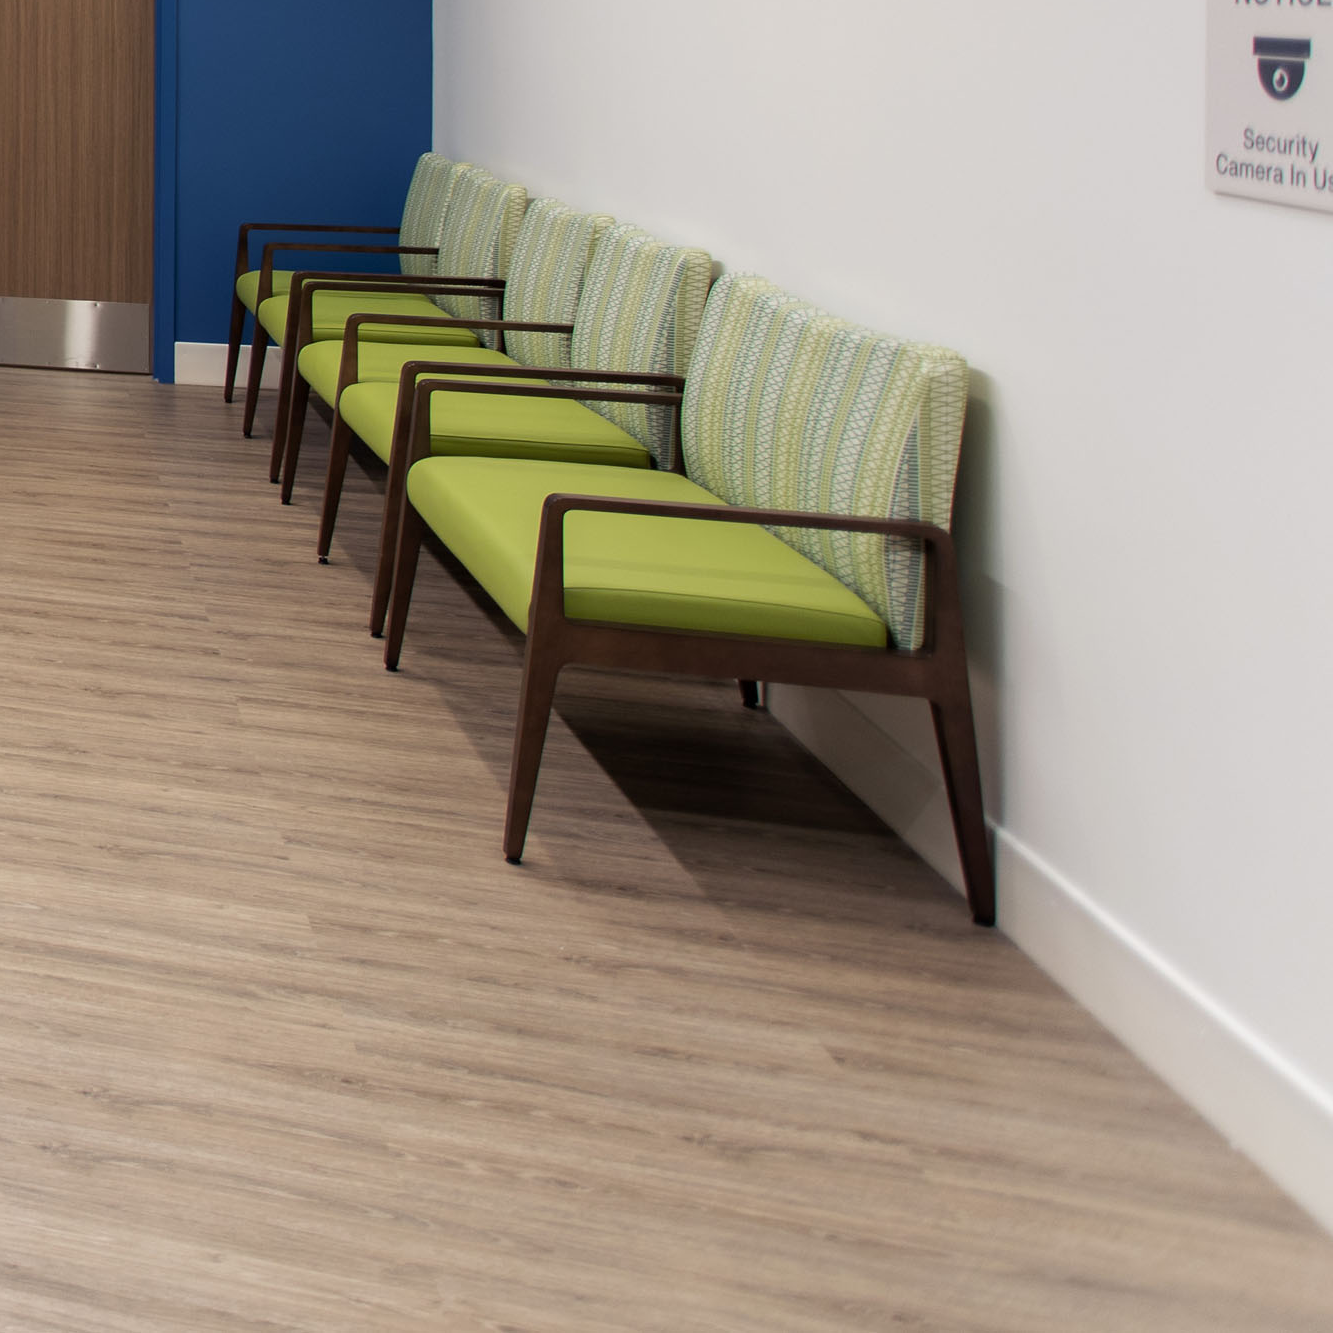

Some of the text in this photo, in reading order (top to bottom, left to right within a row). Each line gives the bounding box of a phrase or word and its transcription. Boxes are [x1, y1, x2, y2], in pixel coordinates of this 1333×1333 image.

[1243, 128, 1320, 163] Security
[1215, 153, 1284, 185] Camera
[1290, 163, 1307, 189] In
